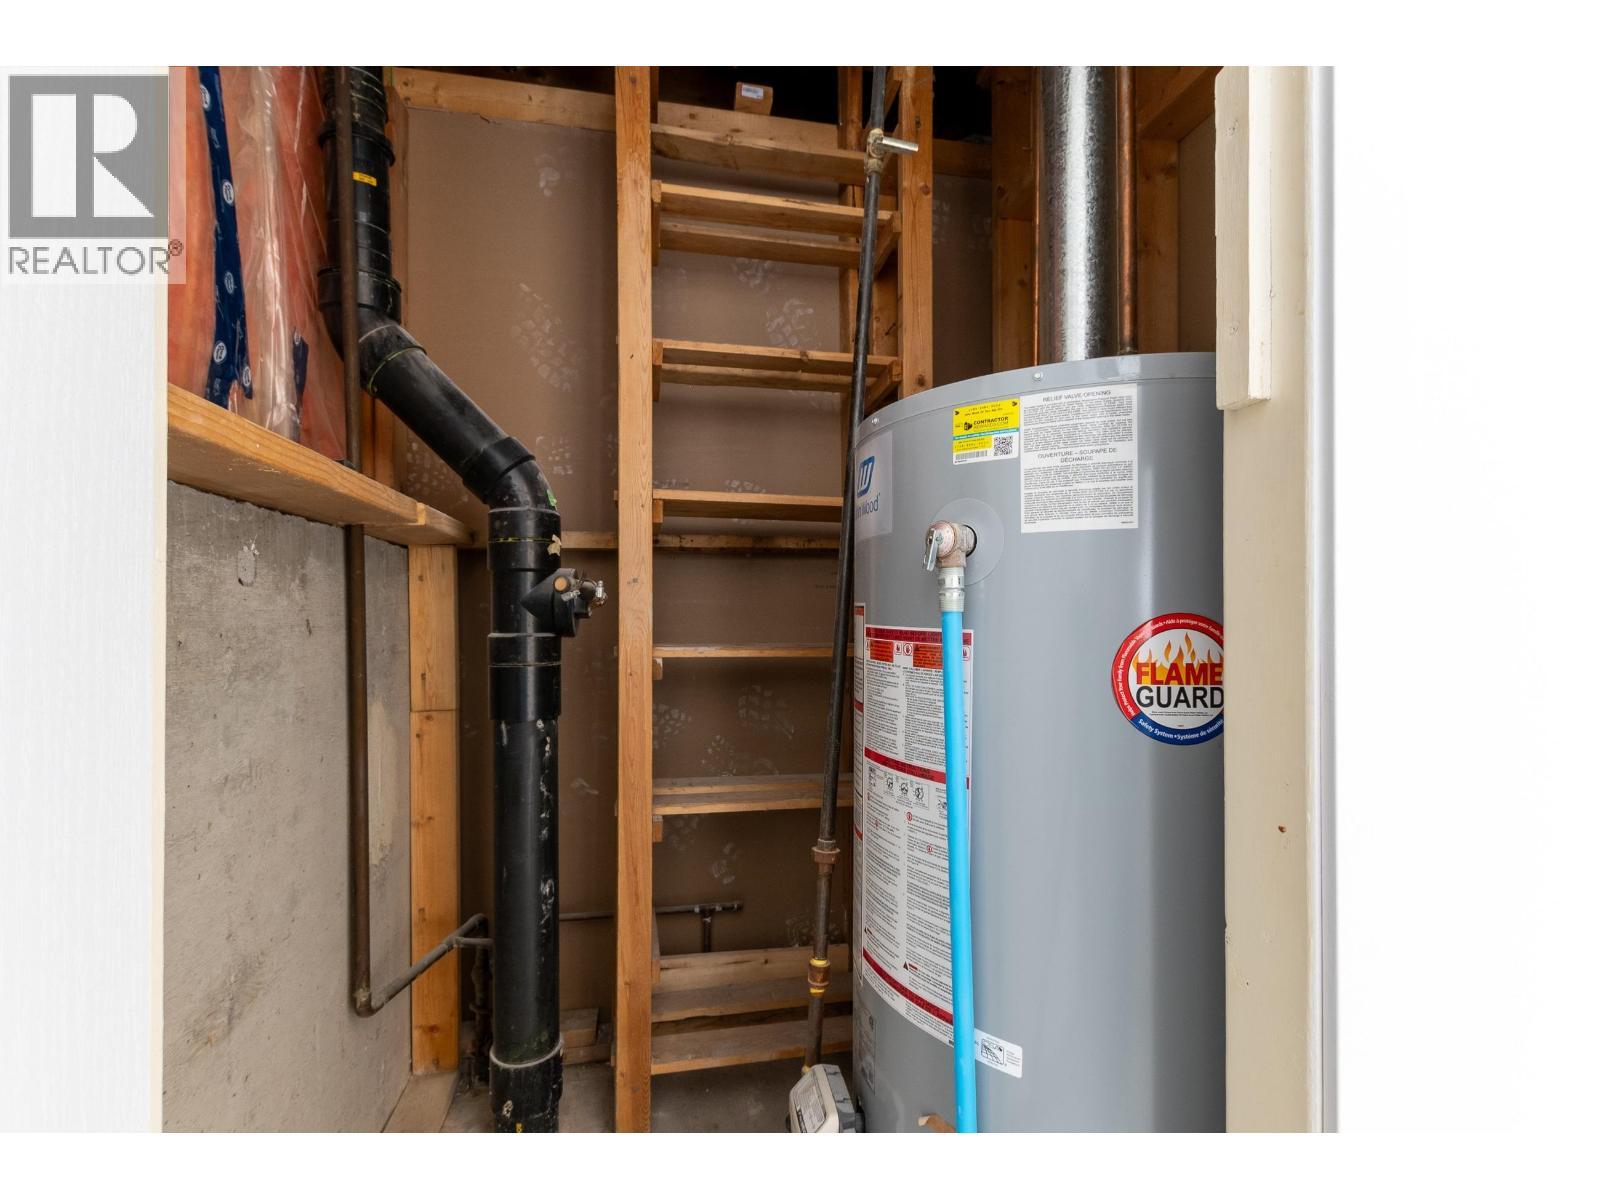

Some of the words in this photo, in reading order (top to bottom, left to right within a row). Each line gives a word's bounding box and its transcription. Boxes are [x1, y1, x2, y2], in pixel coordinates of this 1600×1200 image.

[1064, 392, 1082, 400] VALVE
[1083, 390, 1112, 398] OPENING
[1136, 662, 1224, 685] FLAME
[1136, 686, 1224, 708] GUARD
[1138, 718, 1154, 733] Safety
[1153, 728, 1174, 738] System
